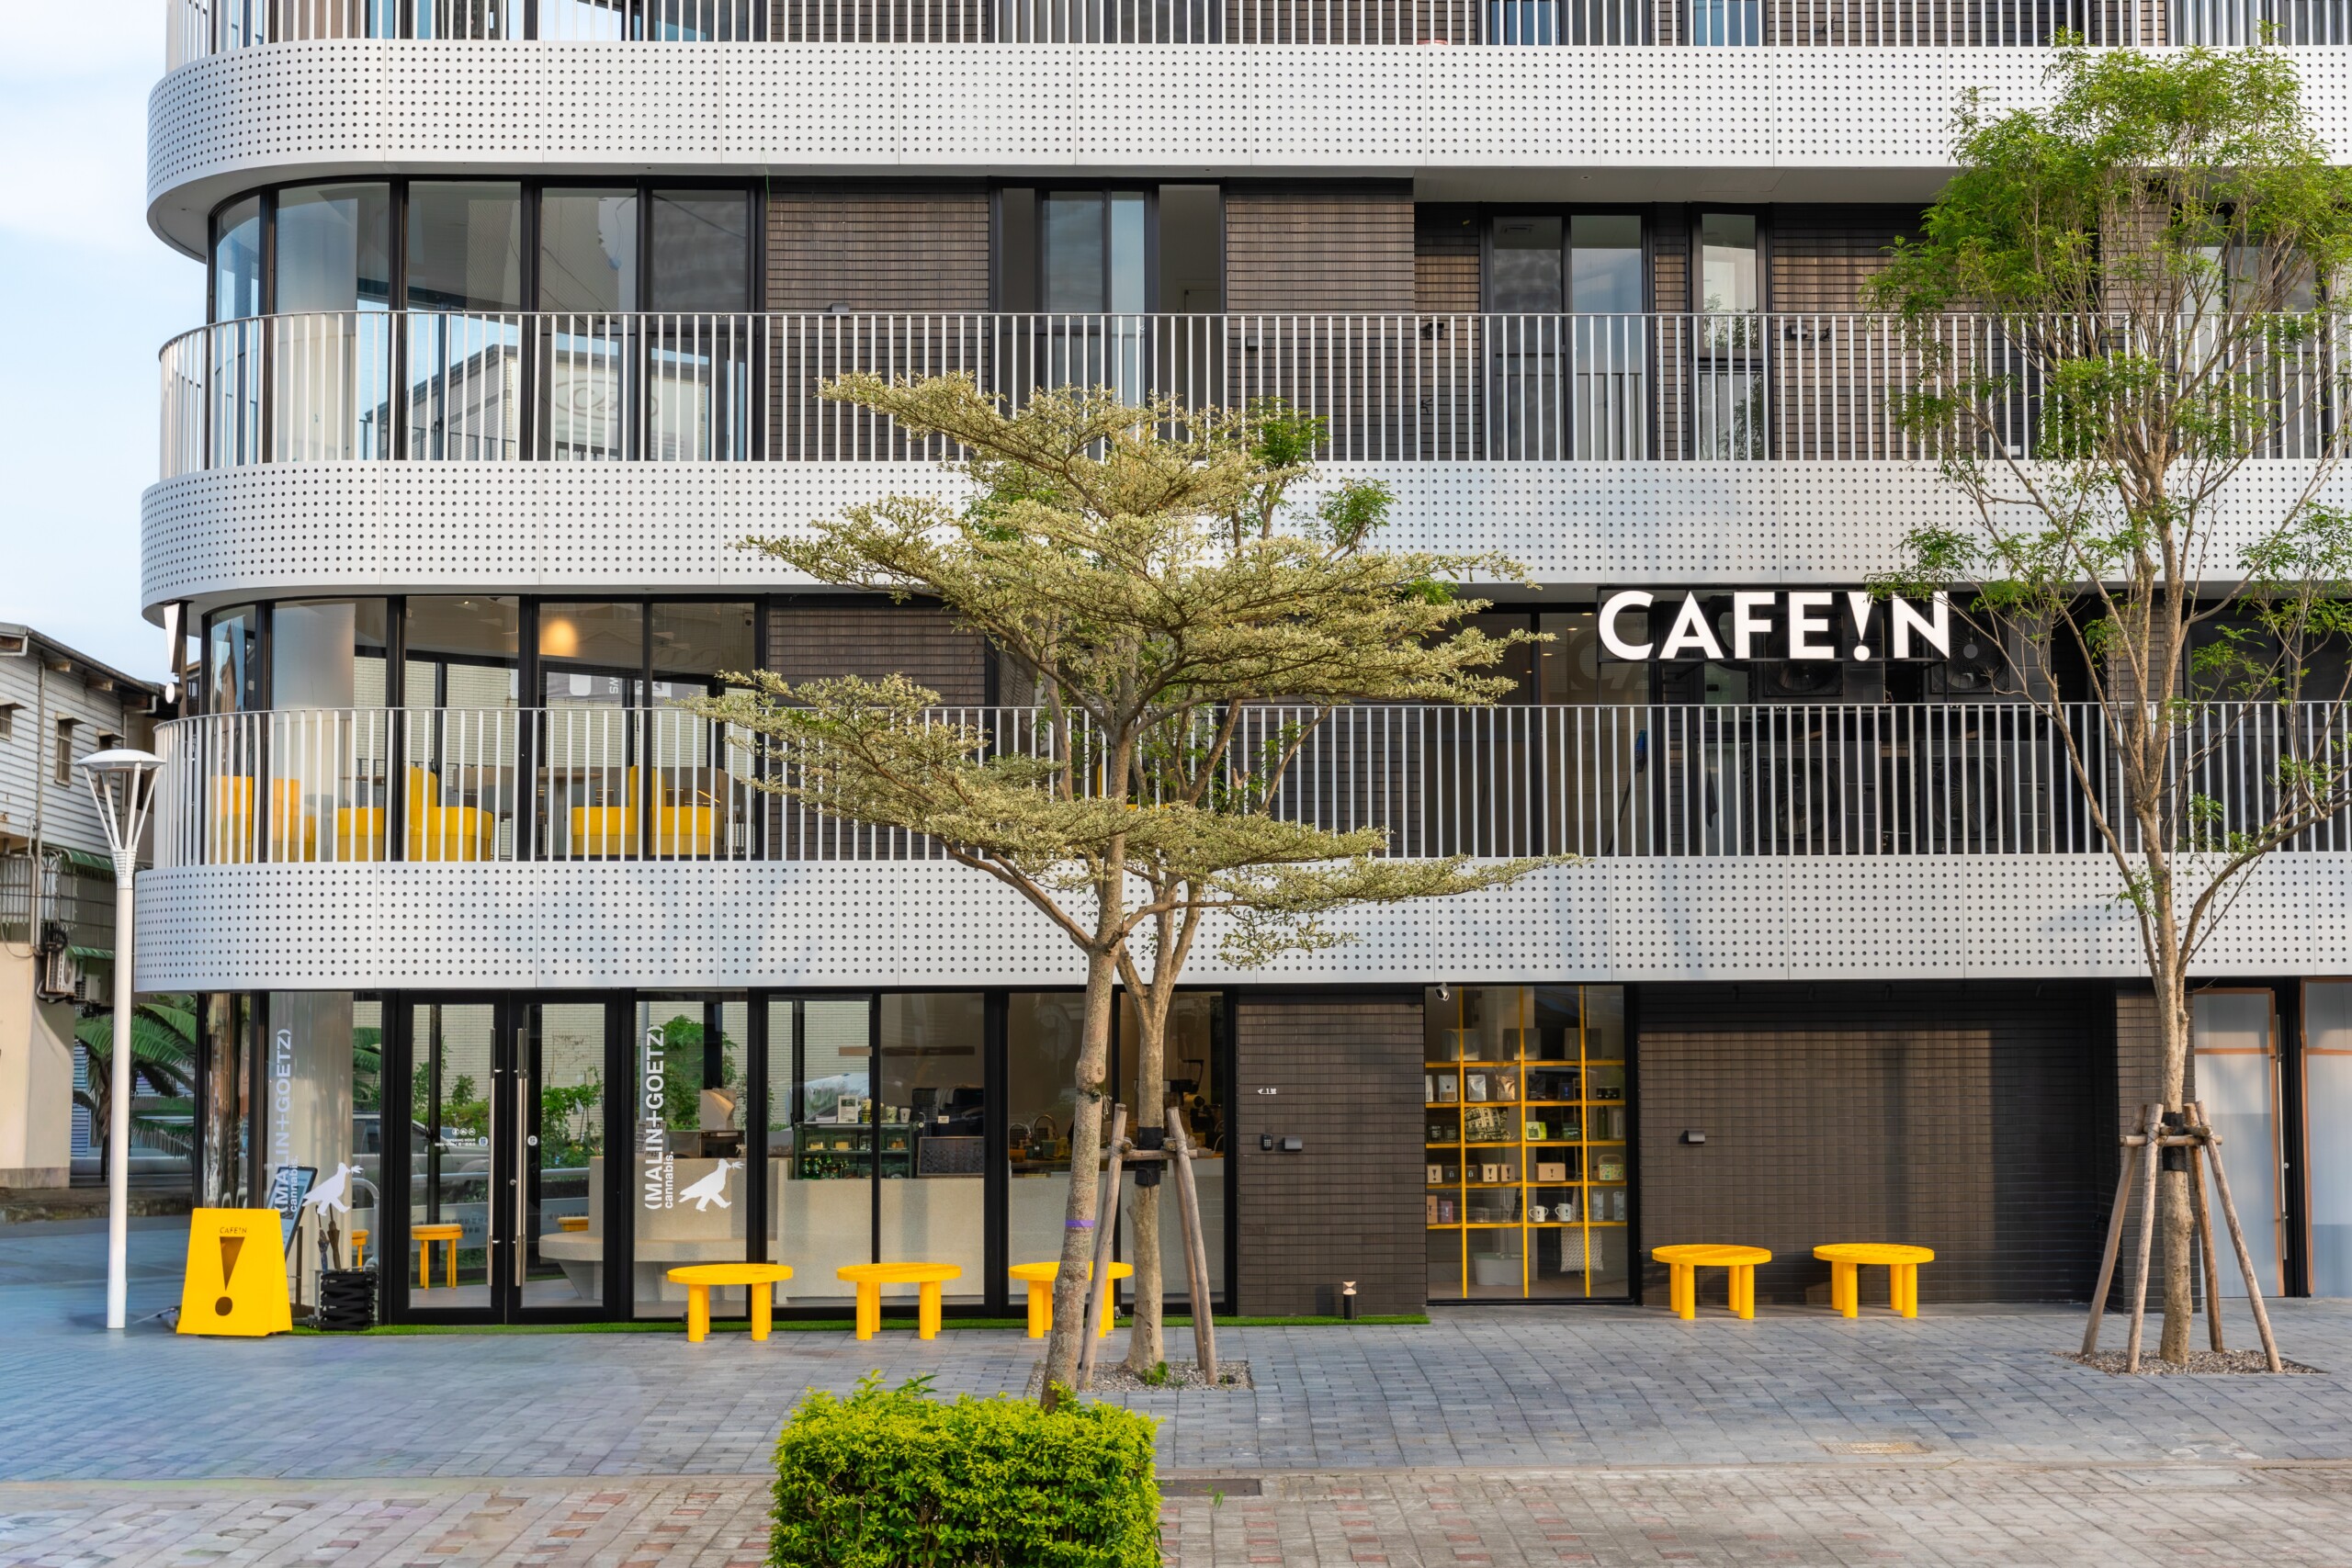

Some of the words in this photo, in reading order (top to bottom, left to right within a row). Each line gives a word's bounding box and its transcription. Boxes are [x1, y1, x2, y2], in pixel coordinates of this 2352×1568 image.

[1599, 590, 1950, 661] CAFE!N
[275, 1029, 291, 1213] (MALIN+GOETZ)
[645, 1025, 664, 1210] (MALIN+GOETZ)
[289, 1155, 299, 1213] cannabis.
[663, 1151, 674, 1209] cannabis.
